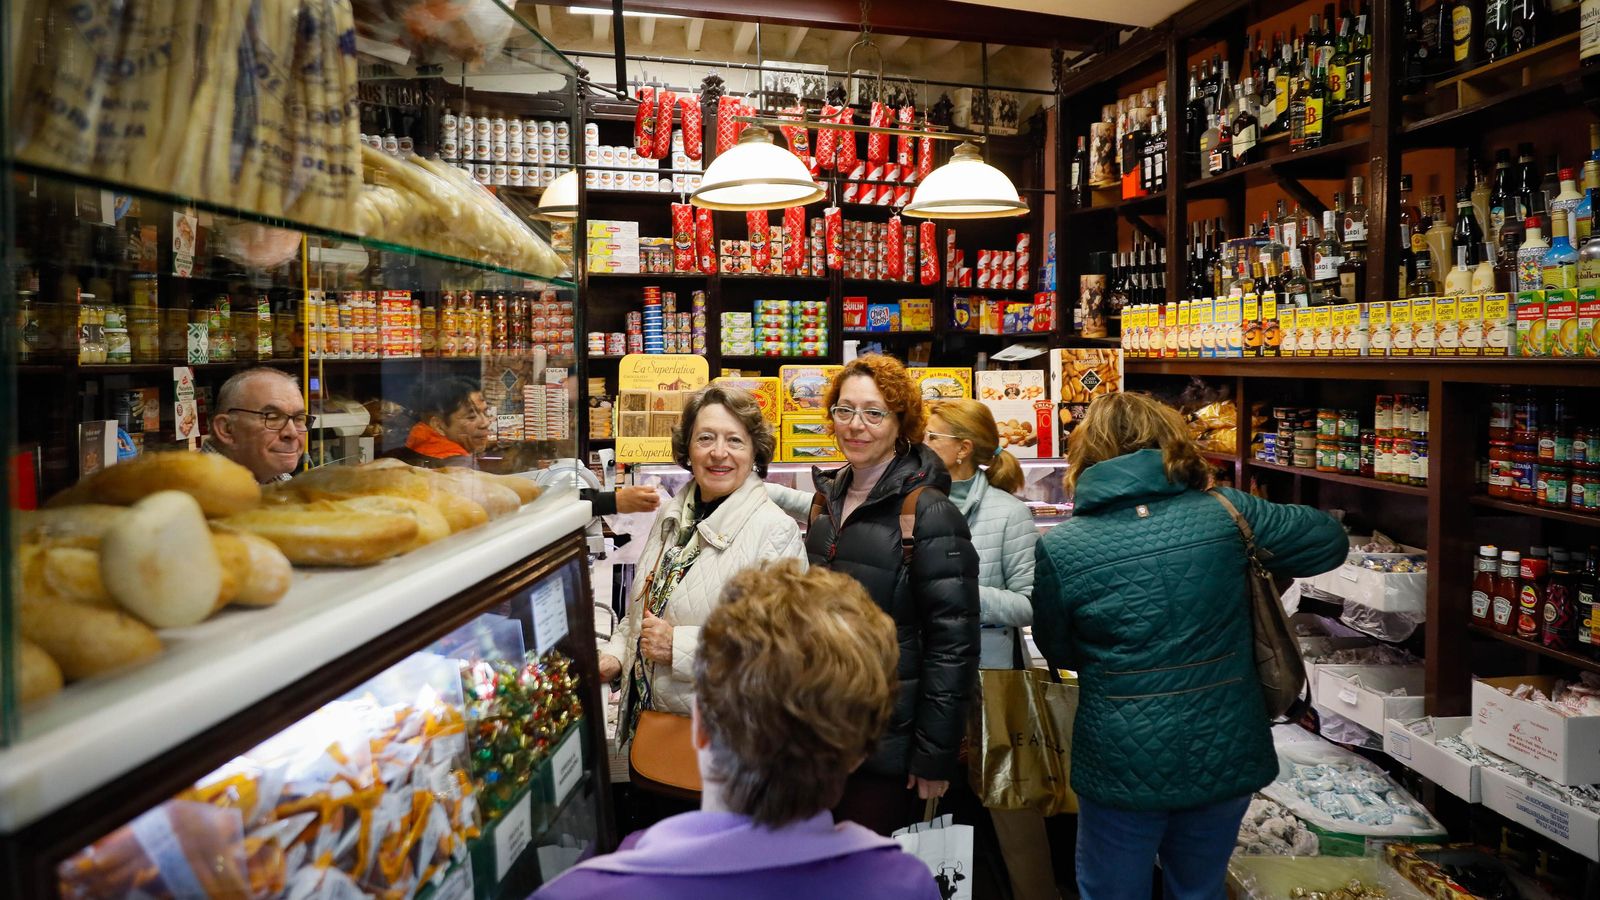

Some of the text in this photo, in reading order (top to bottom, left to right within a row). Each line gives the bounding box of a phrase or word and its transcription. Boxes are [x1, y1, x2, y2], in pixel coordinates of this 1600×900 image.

[633, 360, 696, 377] La Superlativa
[620, 443, 672, 460] La Superla
